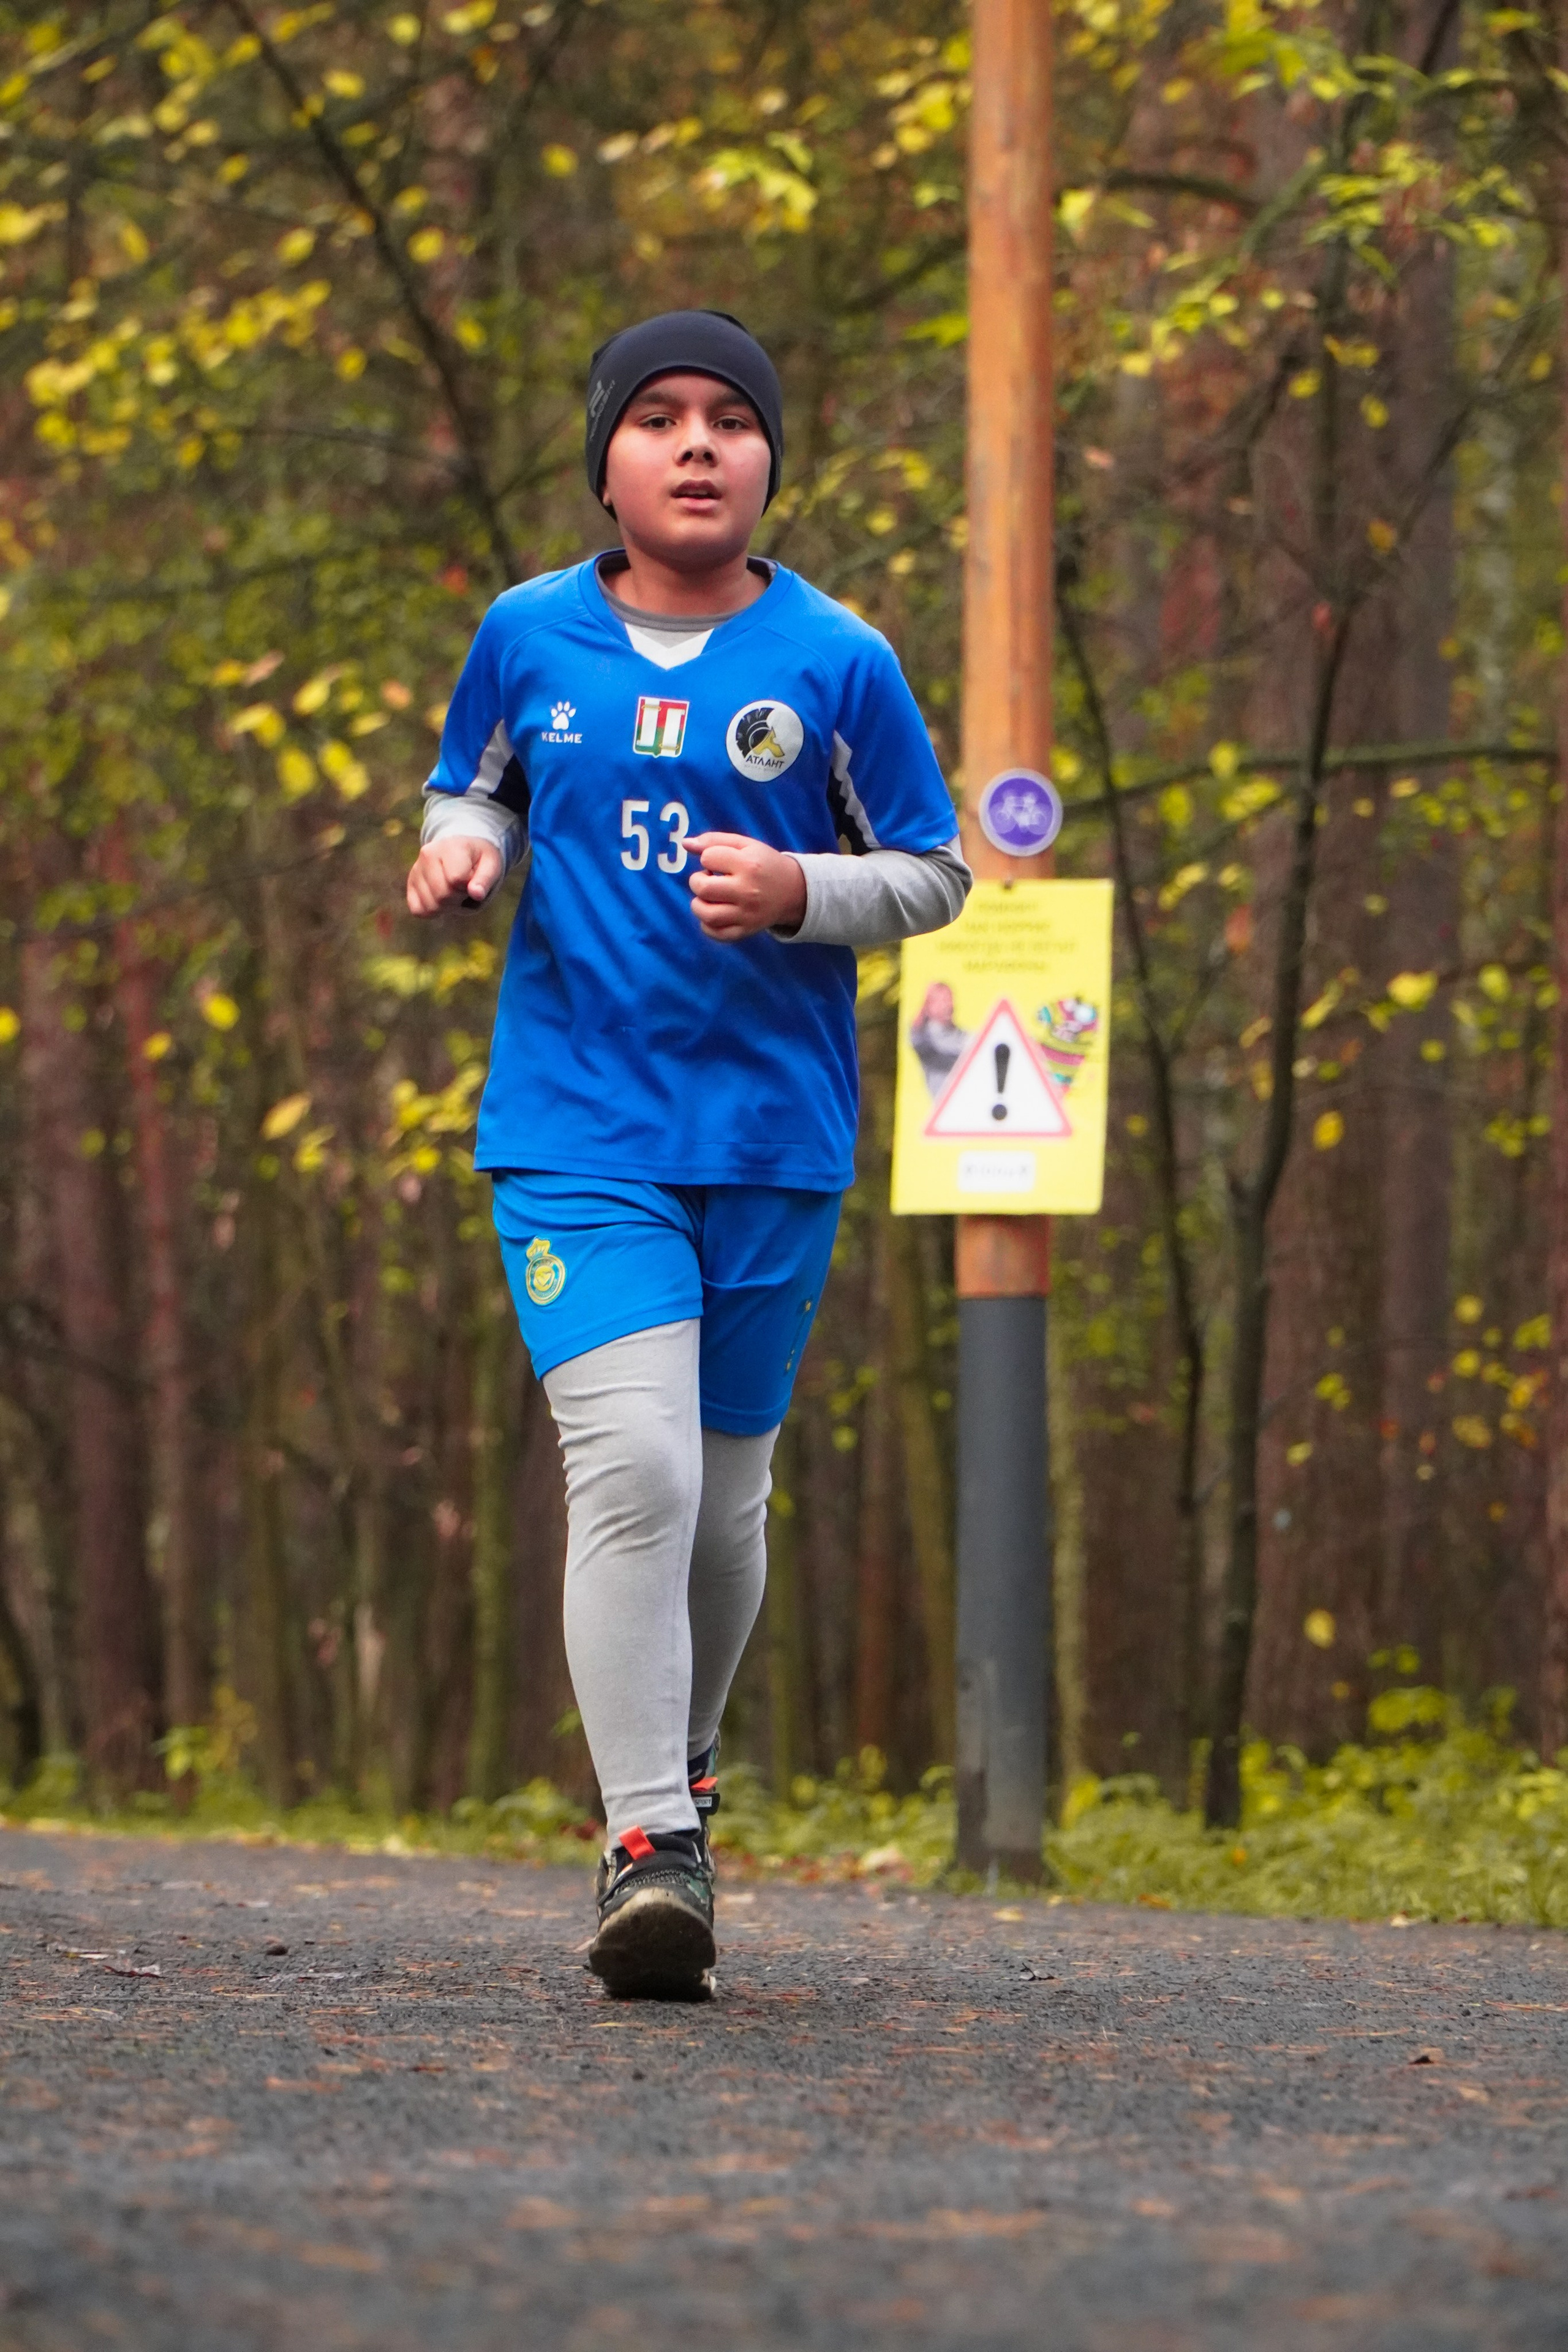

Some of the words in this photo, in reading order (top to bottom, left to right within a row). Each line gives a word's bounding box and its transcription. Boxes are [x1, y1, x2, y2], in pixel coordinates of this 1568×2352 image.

[541, 731, 582, 744] KELME
[745, 755, 785, 769] АТЛАНТ
[620, 799, 690, 874] 53
